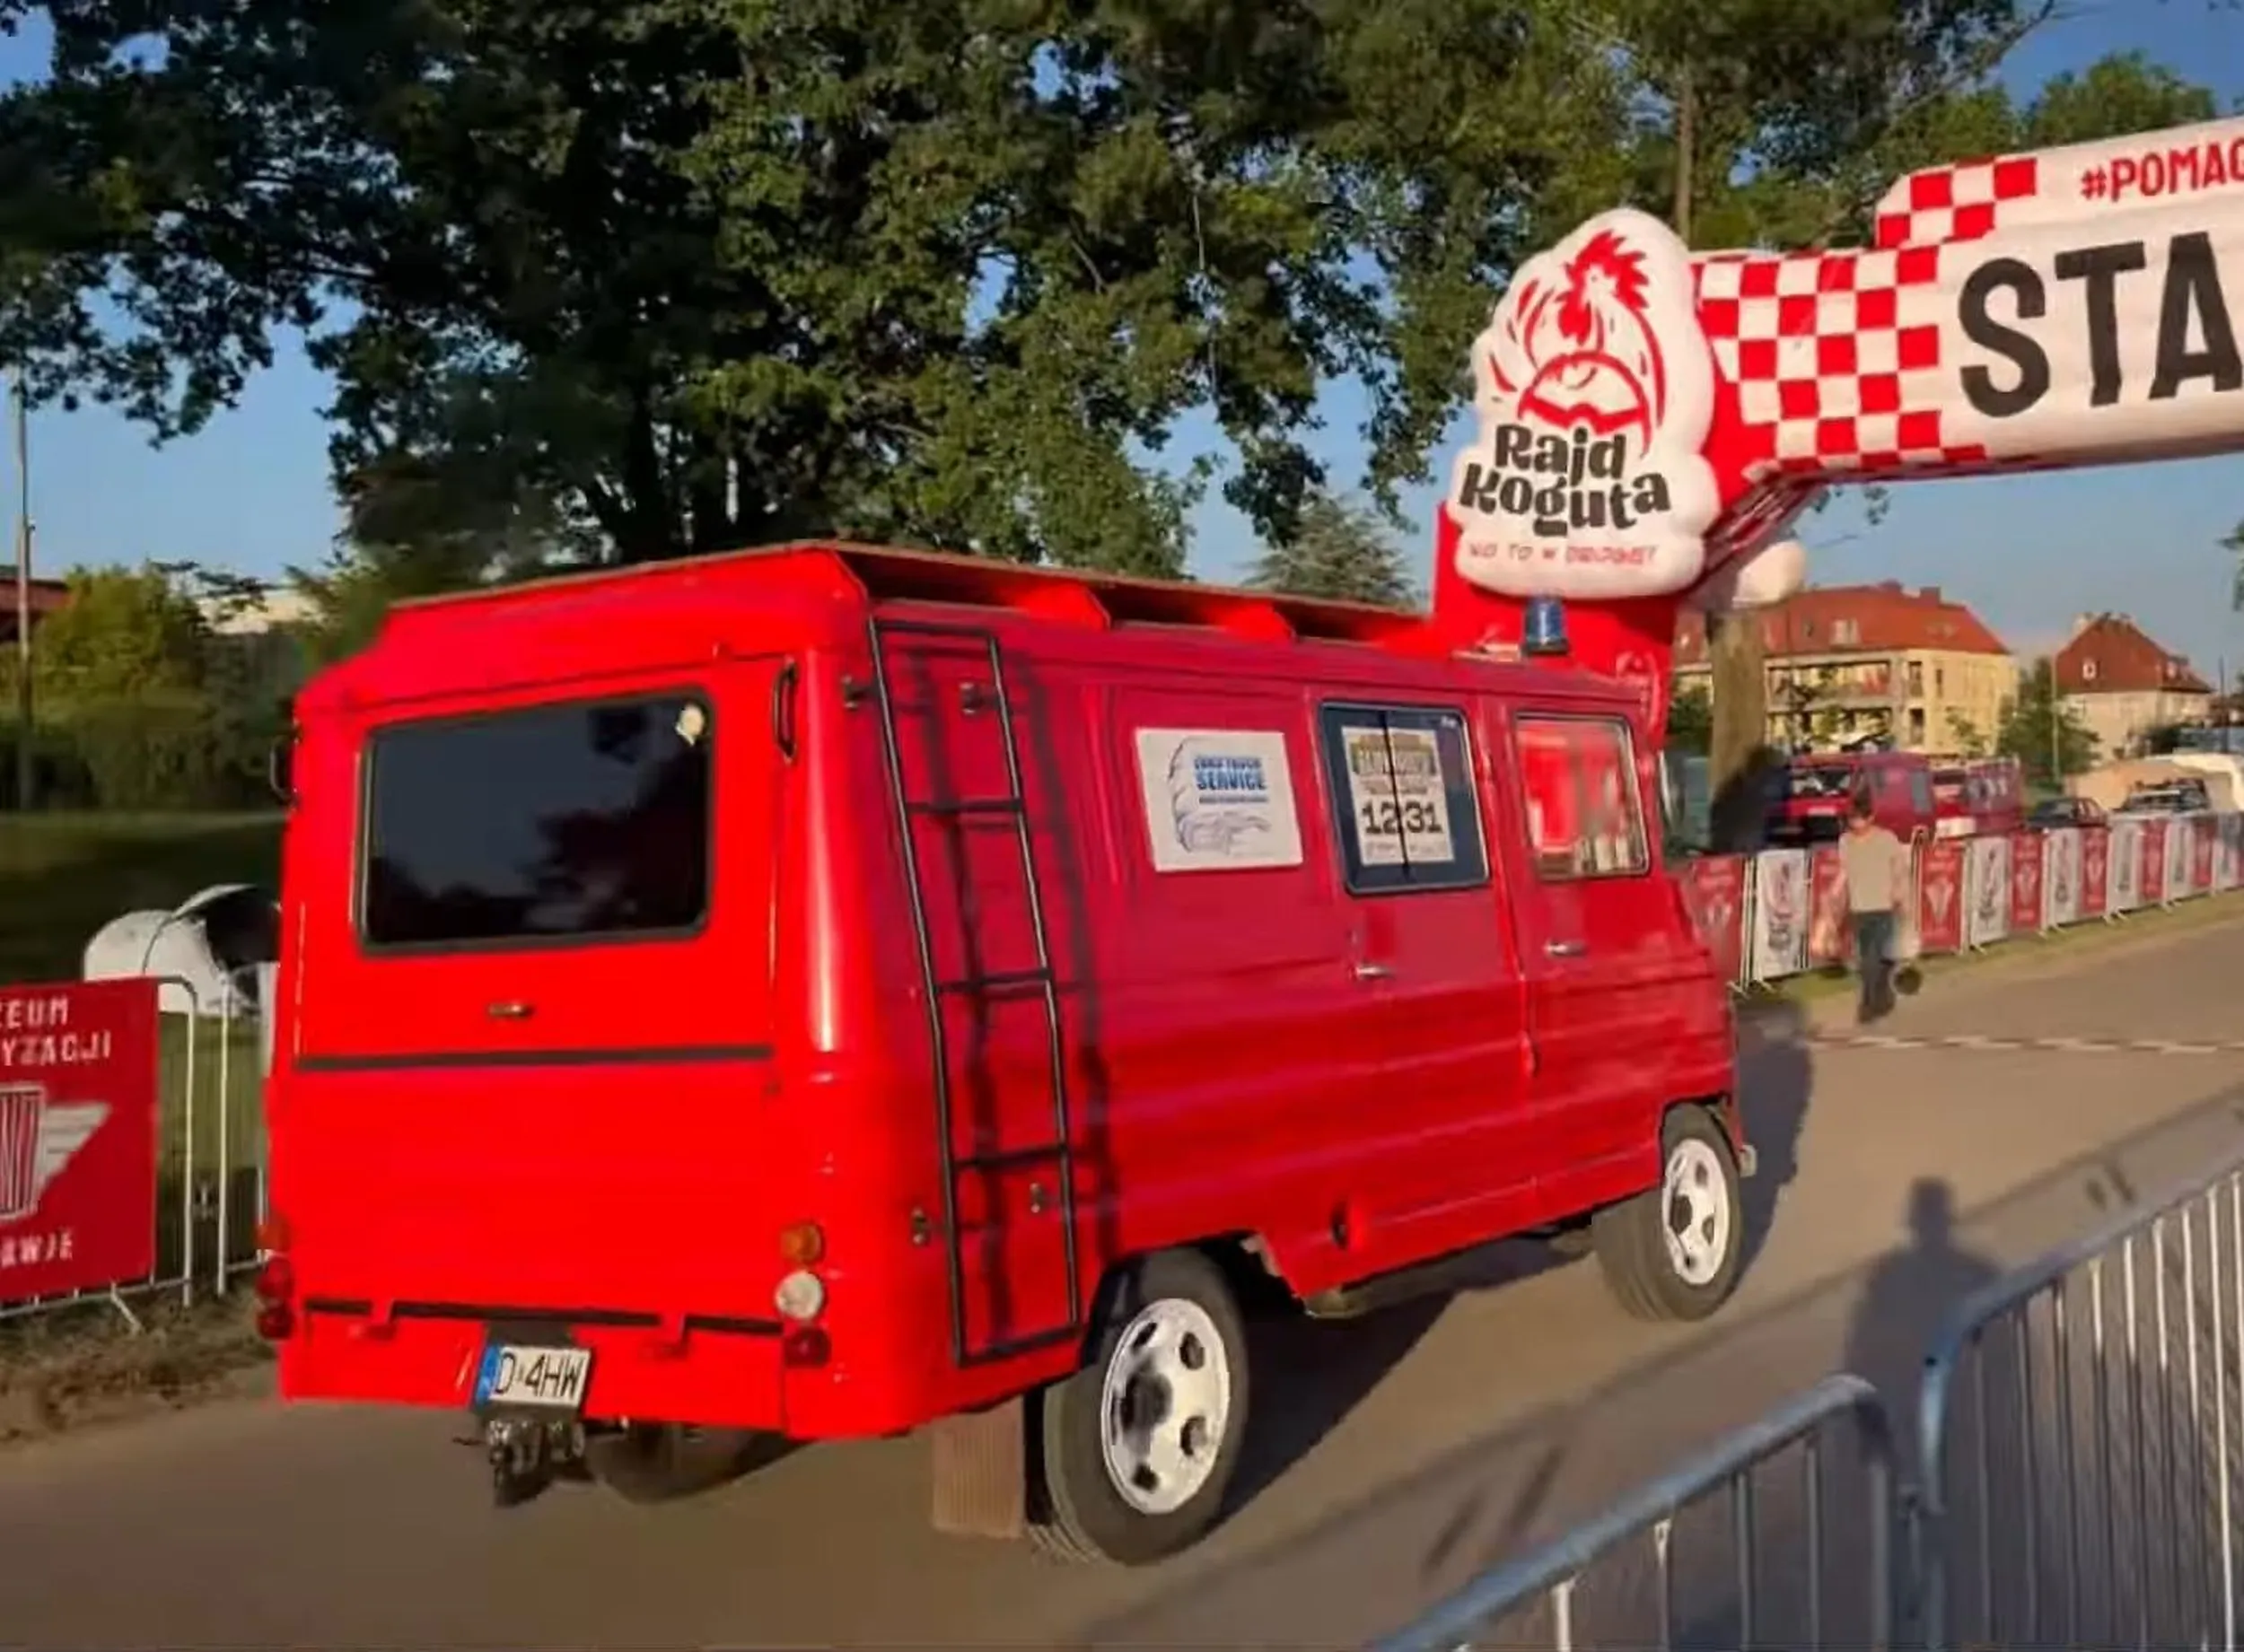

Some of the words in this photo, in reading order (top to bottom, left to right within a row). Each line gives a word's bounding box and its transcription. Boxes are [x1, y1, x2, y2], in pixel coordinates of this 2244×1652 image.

[1958, 231, 2243, 418] STA
[1495, 424, 1627, 487] Rajd
[1459, 462, 1671, 538] Koguta
[1362, 800, 1443, 835] 1231
[0, 993, 69, 1030] EUM
